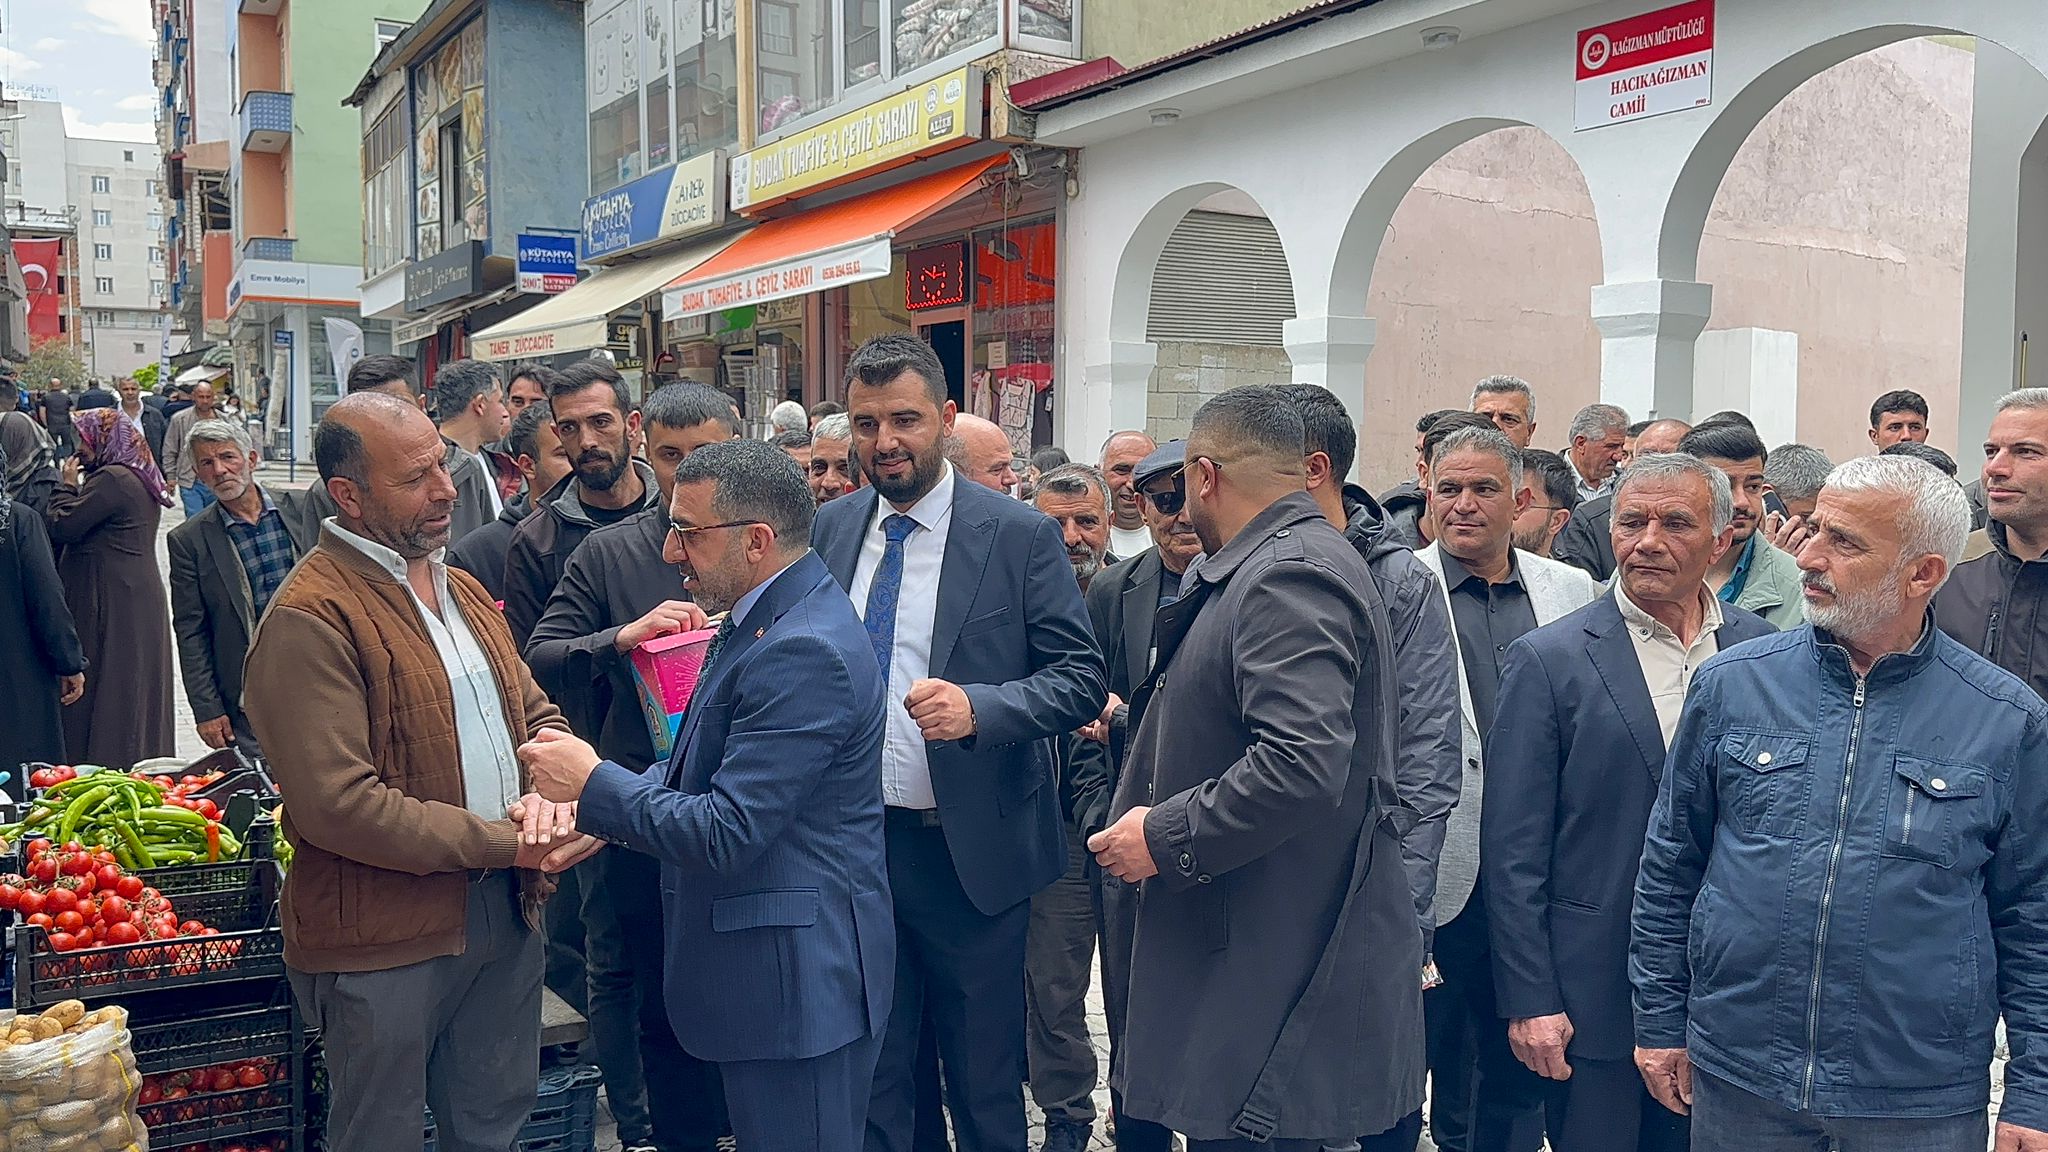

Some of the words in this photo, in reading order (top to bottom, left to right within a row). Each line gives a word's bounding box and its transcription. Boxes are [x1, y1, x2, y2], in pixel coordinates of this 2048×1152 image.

[1612, 33, 1655, 57] KAĞIZMAN
[1654, 17, 1705, 45] MÜFTÜLÜĞÜ
[1611, 61, 1707, 96] HACIKAĞIZMAN
[1610, 94, 1645, 118] CAMİİ
[754, 151, 785, 190] BUDAK
[787, 132, 828, 179] TUAFİYE
[831, 136, 839, 163] &
[843, 111, 873, 168] ÇEYİZ
[877, 99, 919, 147] SARAYI
[527, 247, 574, 259] KÜTAHYA
[251, 274, 272, 282] Emre
[275, 275, 305, 284] Mobilya
[681, 294, 705, 312] BUDAK
[708, 280, 742, 306] TUHAFİYE
[747, 281, 752, 298] &
[756, 270, 779, 301] ÇEYİZ
[783, 265, 813, 291] SARAYI
[490, 340, 511, 358] TANER
[515, 333, 554, 354] ZÜCCACİYE
